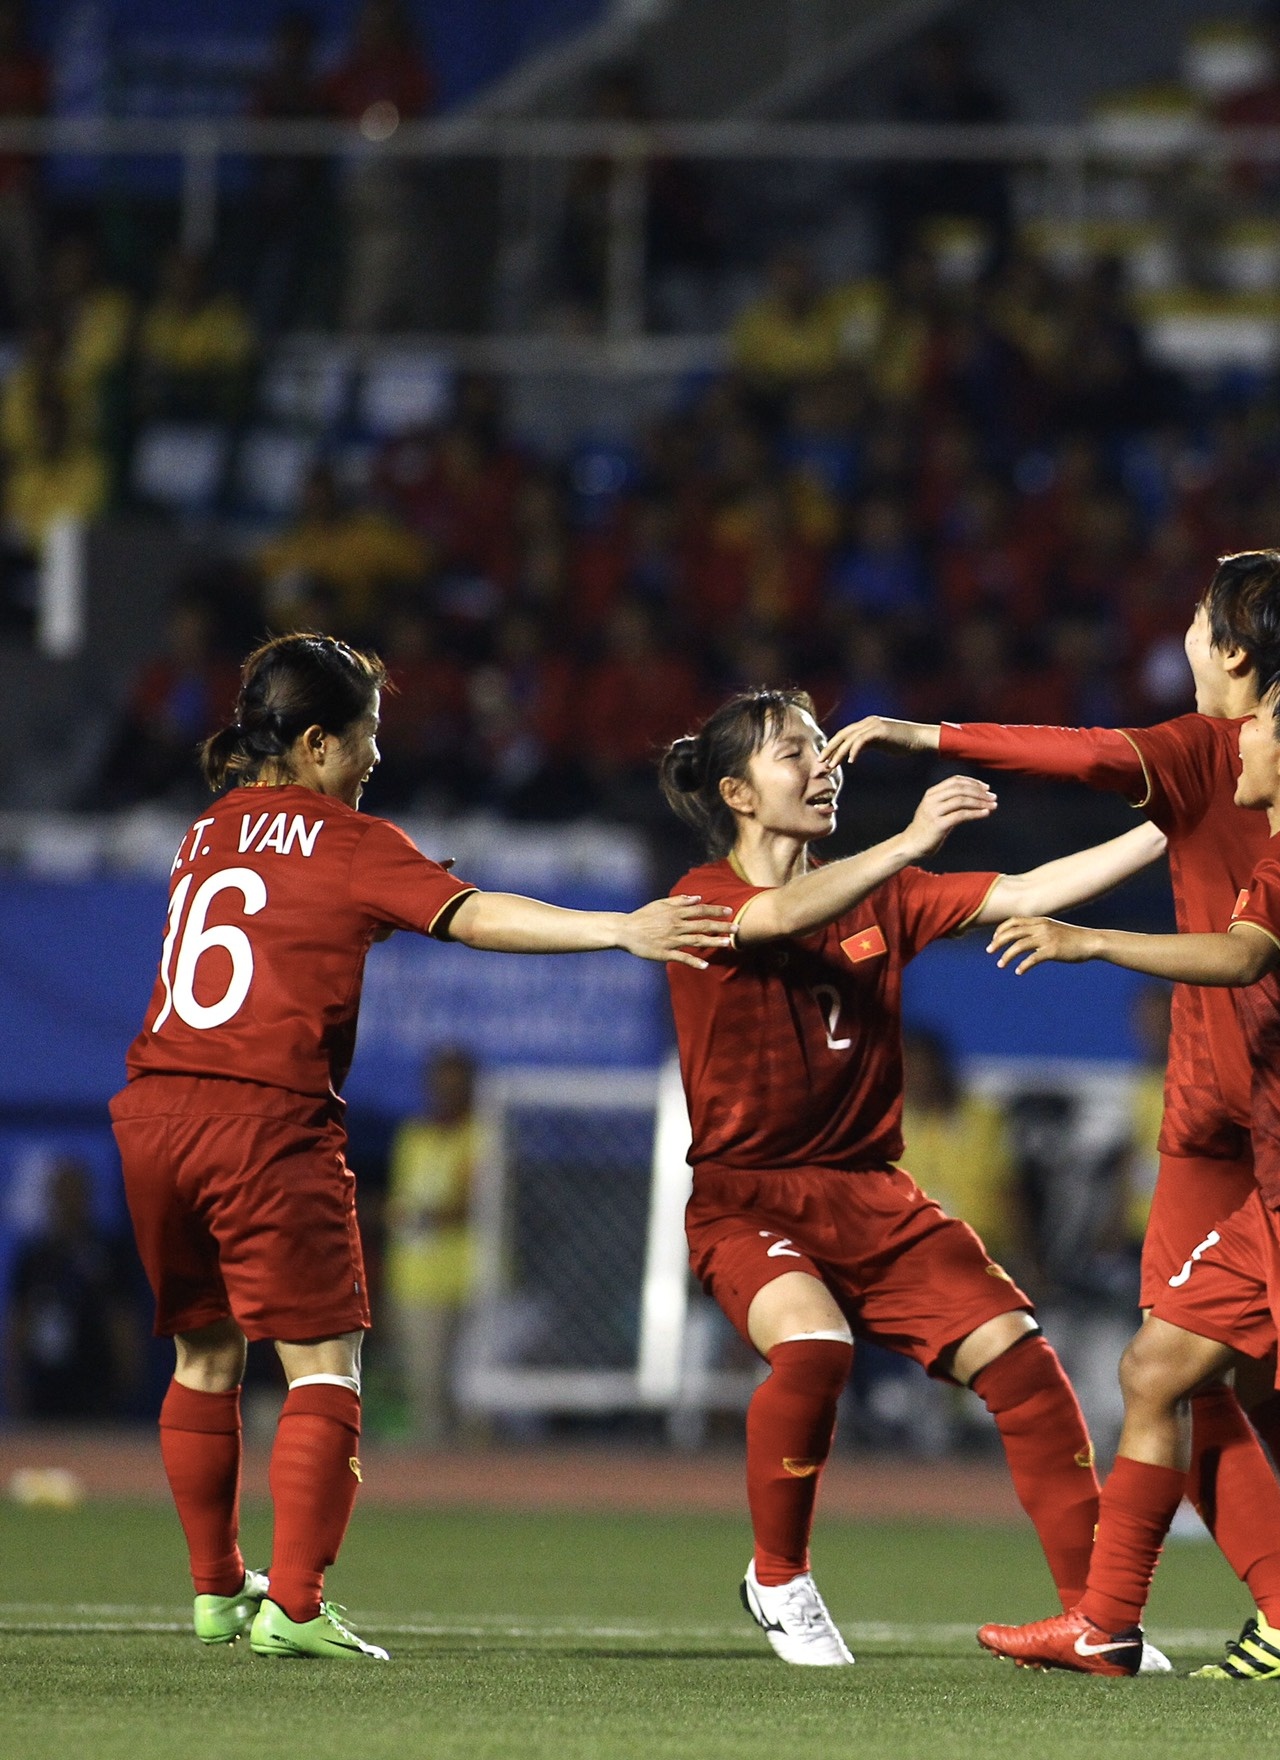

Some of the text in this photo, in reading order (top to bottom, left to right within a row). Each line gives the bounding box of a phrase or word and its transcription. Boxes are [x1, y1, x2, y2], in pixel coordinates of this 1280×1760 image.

[237, 812, 324, 857] VAN
[152, 866, 268, 1033] 16
[808, 983, 851, 1050] 2
[758, 1230, 802, 1258] 2
